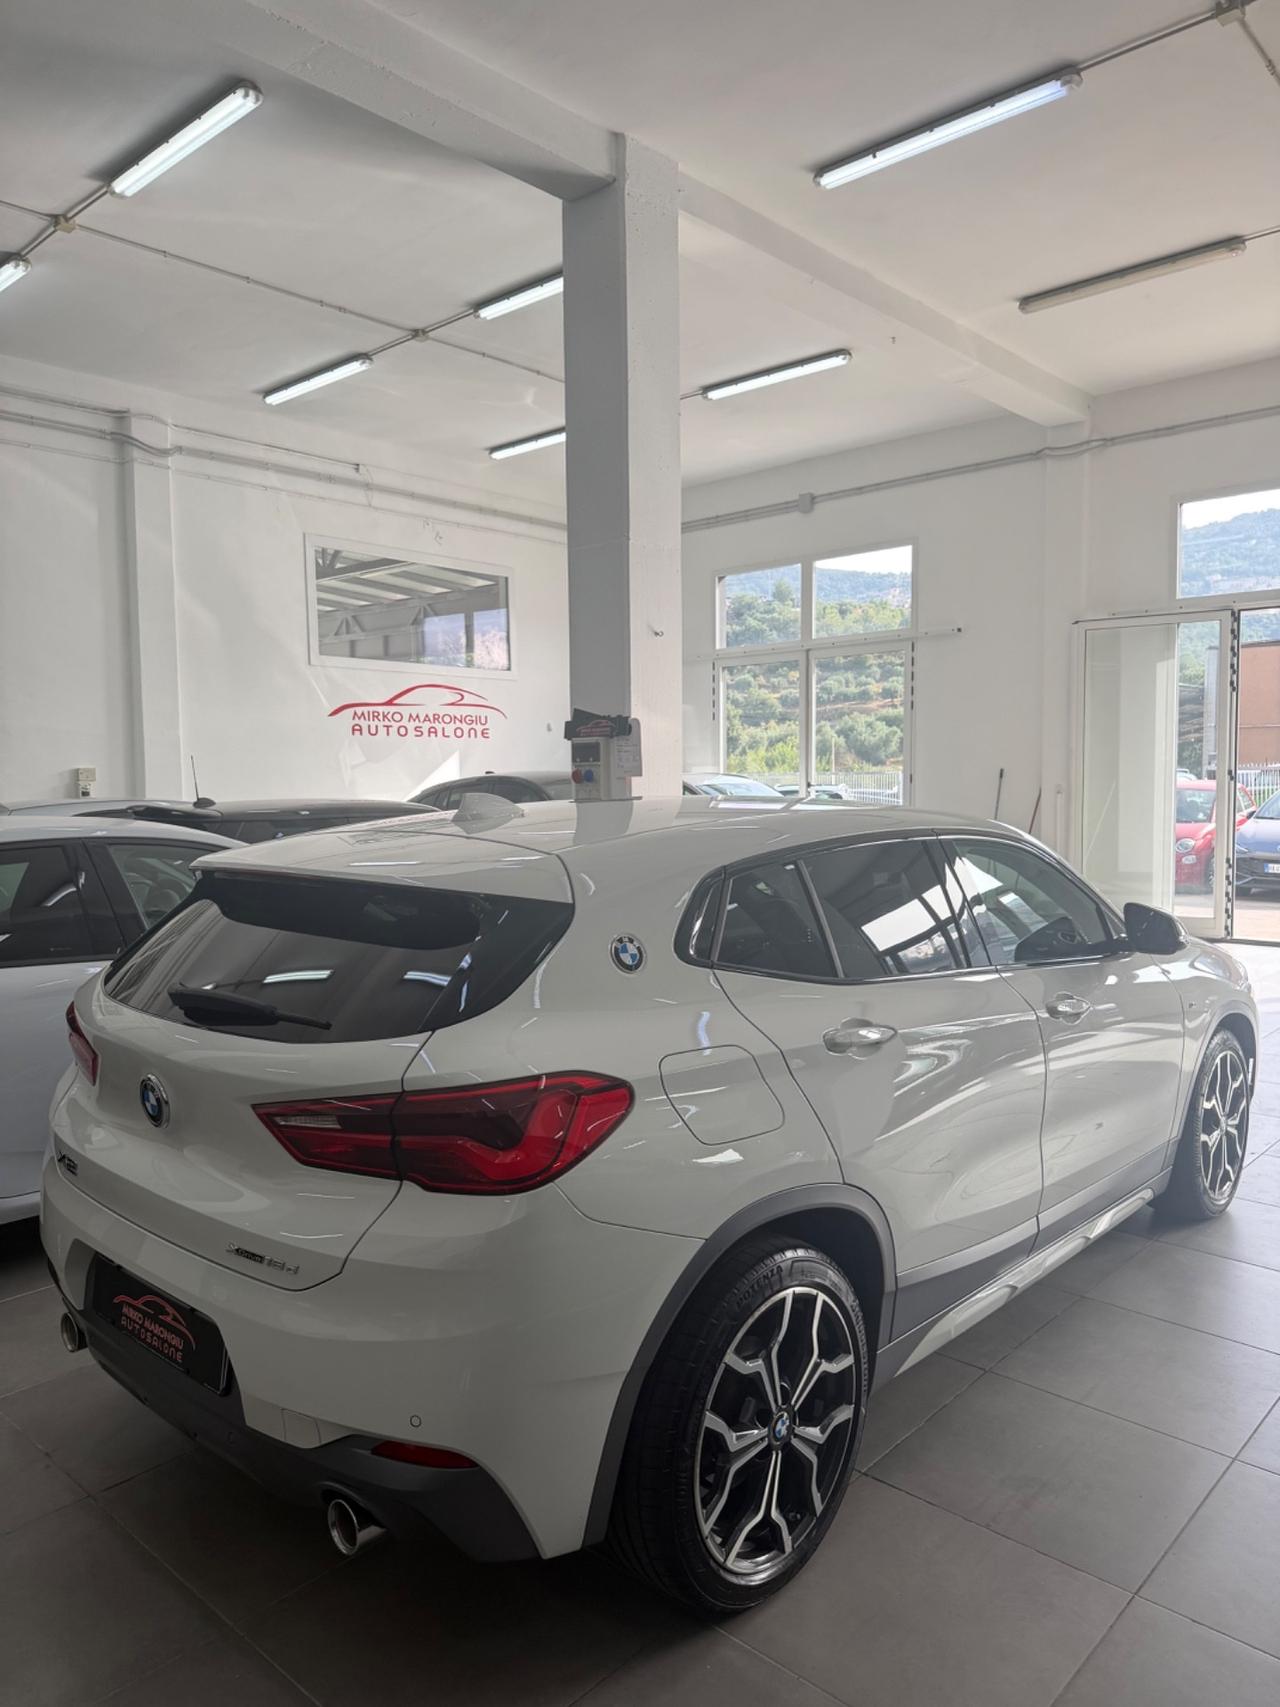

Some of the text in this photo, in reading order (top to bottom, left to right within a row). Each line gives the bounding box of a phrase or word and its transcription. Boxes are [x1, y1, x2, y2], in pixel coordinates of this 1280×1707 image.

[352, 709, 489, 726] MIRKO MARONGIU
[351, 723, 491, 739] AUTOSALONE
[57, 1150, 78, 1176] X2
[120, 1316, 183, 1363] AUTOSALONE
